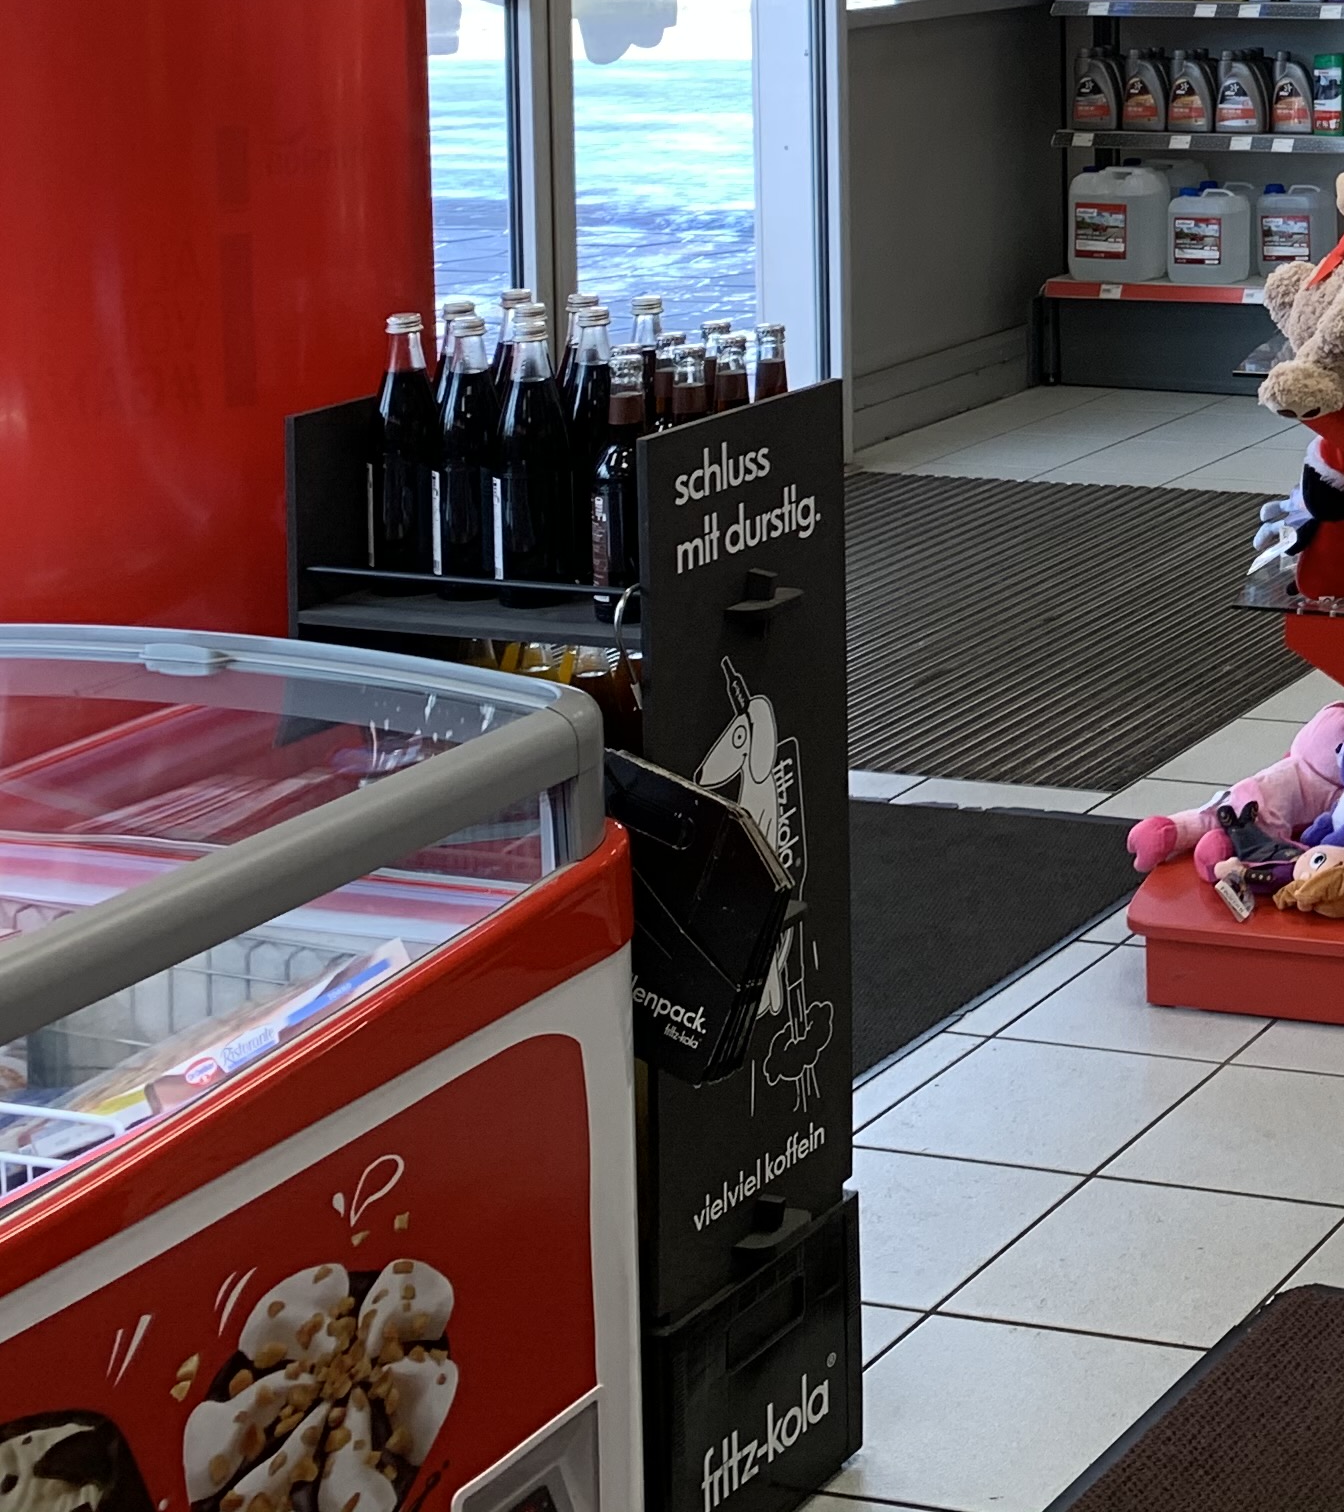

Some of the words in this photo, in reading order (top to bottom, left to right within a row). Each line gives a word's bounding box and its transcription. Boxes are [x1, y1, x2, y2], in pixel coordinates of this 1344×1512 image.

[674, 440, 771, 506] schluss
[676, 511, 720, 575] mit
[724, 483, 822, 554] durstig.
[772, 758, 800, 870] fritz-kola
[663, 1021, 699, 1050] fritz-kola
[693, 1157, 761, 1232] vielviel
[764, 1122, 826, 1185] koffein
[702, 1373, 830, 1512] fritz-kola
